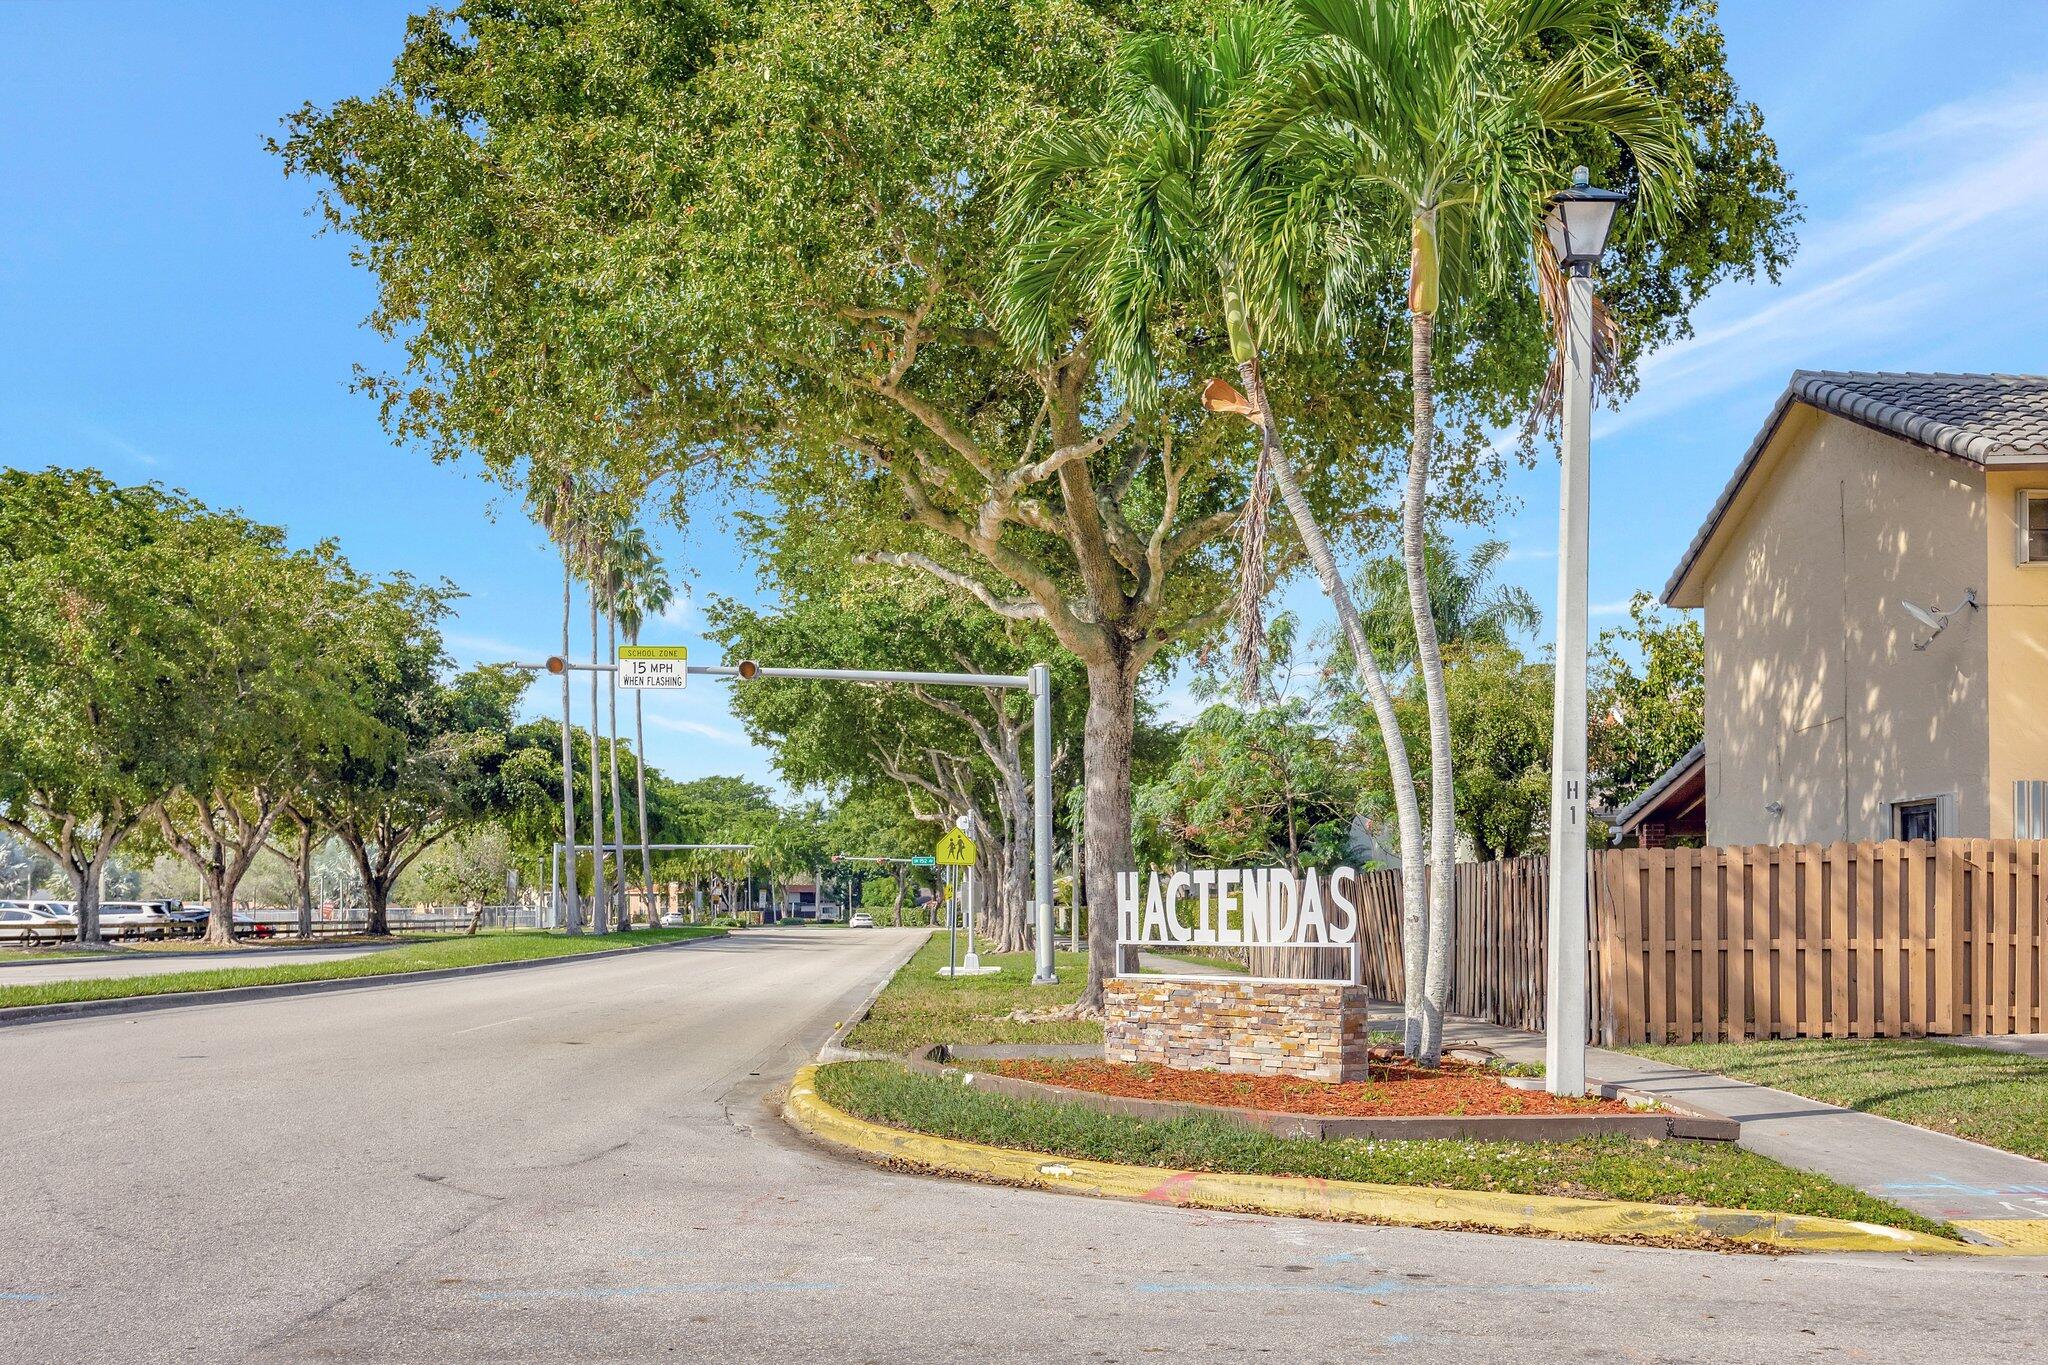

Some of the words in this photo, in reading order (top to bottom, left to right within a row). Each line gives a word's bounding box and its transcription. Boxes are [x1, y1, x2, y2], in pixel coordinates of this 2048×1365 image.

[632, 661, 647, 674] 15
[650, 663, 673, 673] MPH
[623, 676, 644, 686] WHEN
[646, 676, 682, 687] FLASHING
[1566, 780, 1579, 800] H
[1570, 805, 1576, 825] 1
[1117, 866, 1358, 943] HACIENDAS
